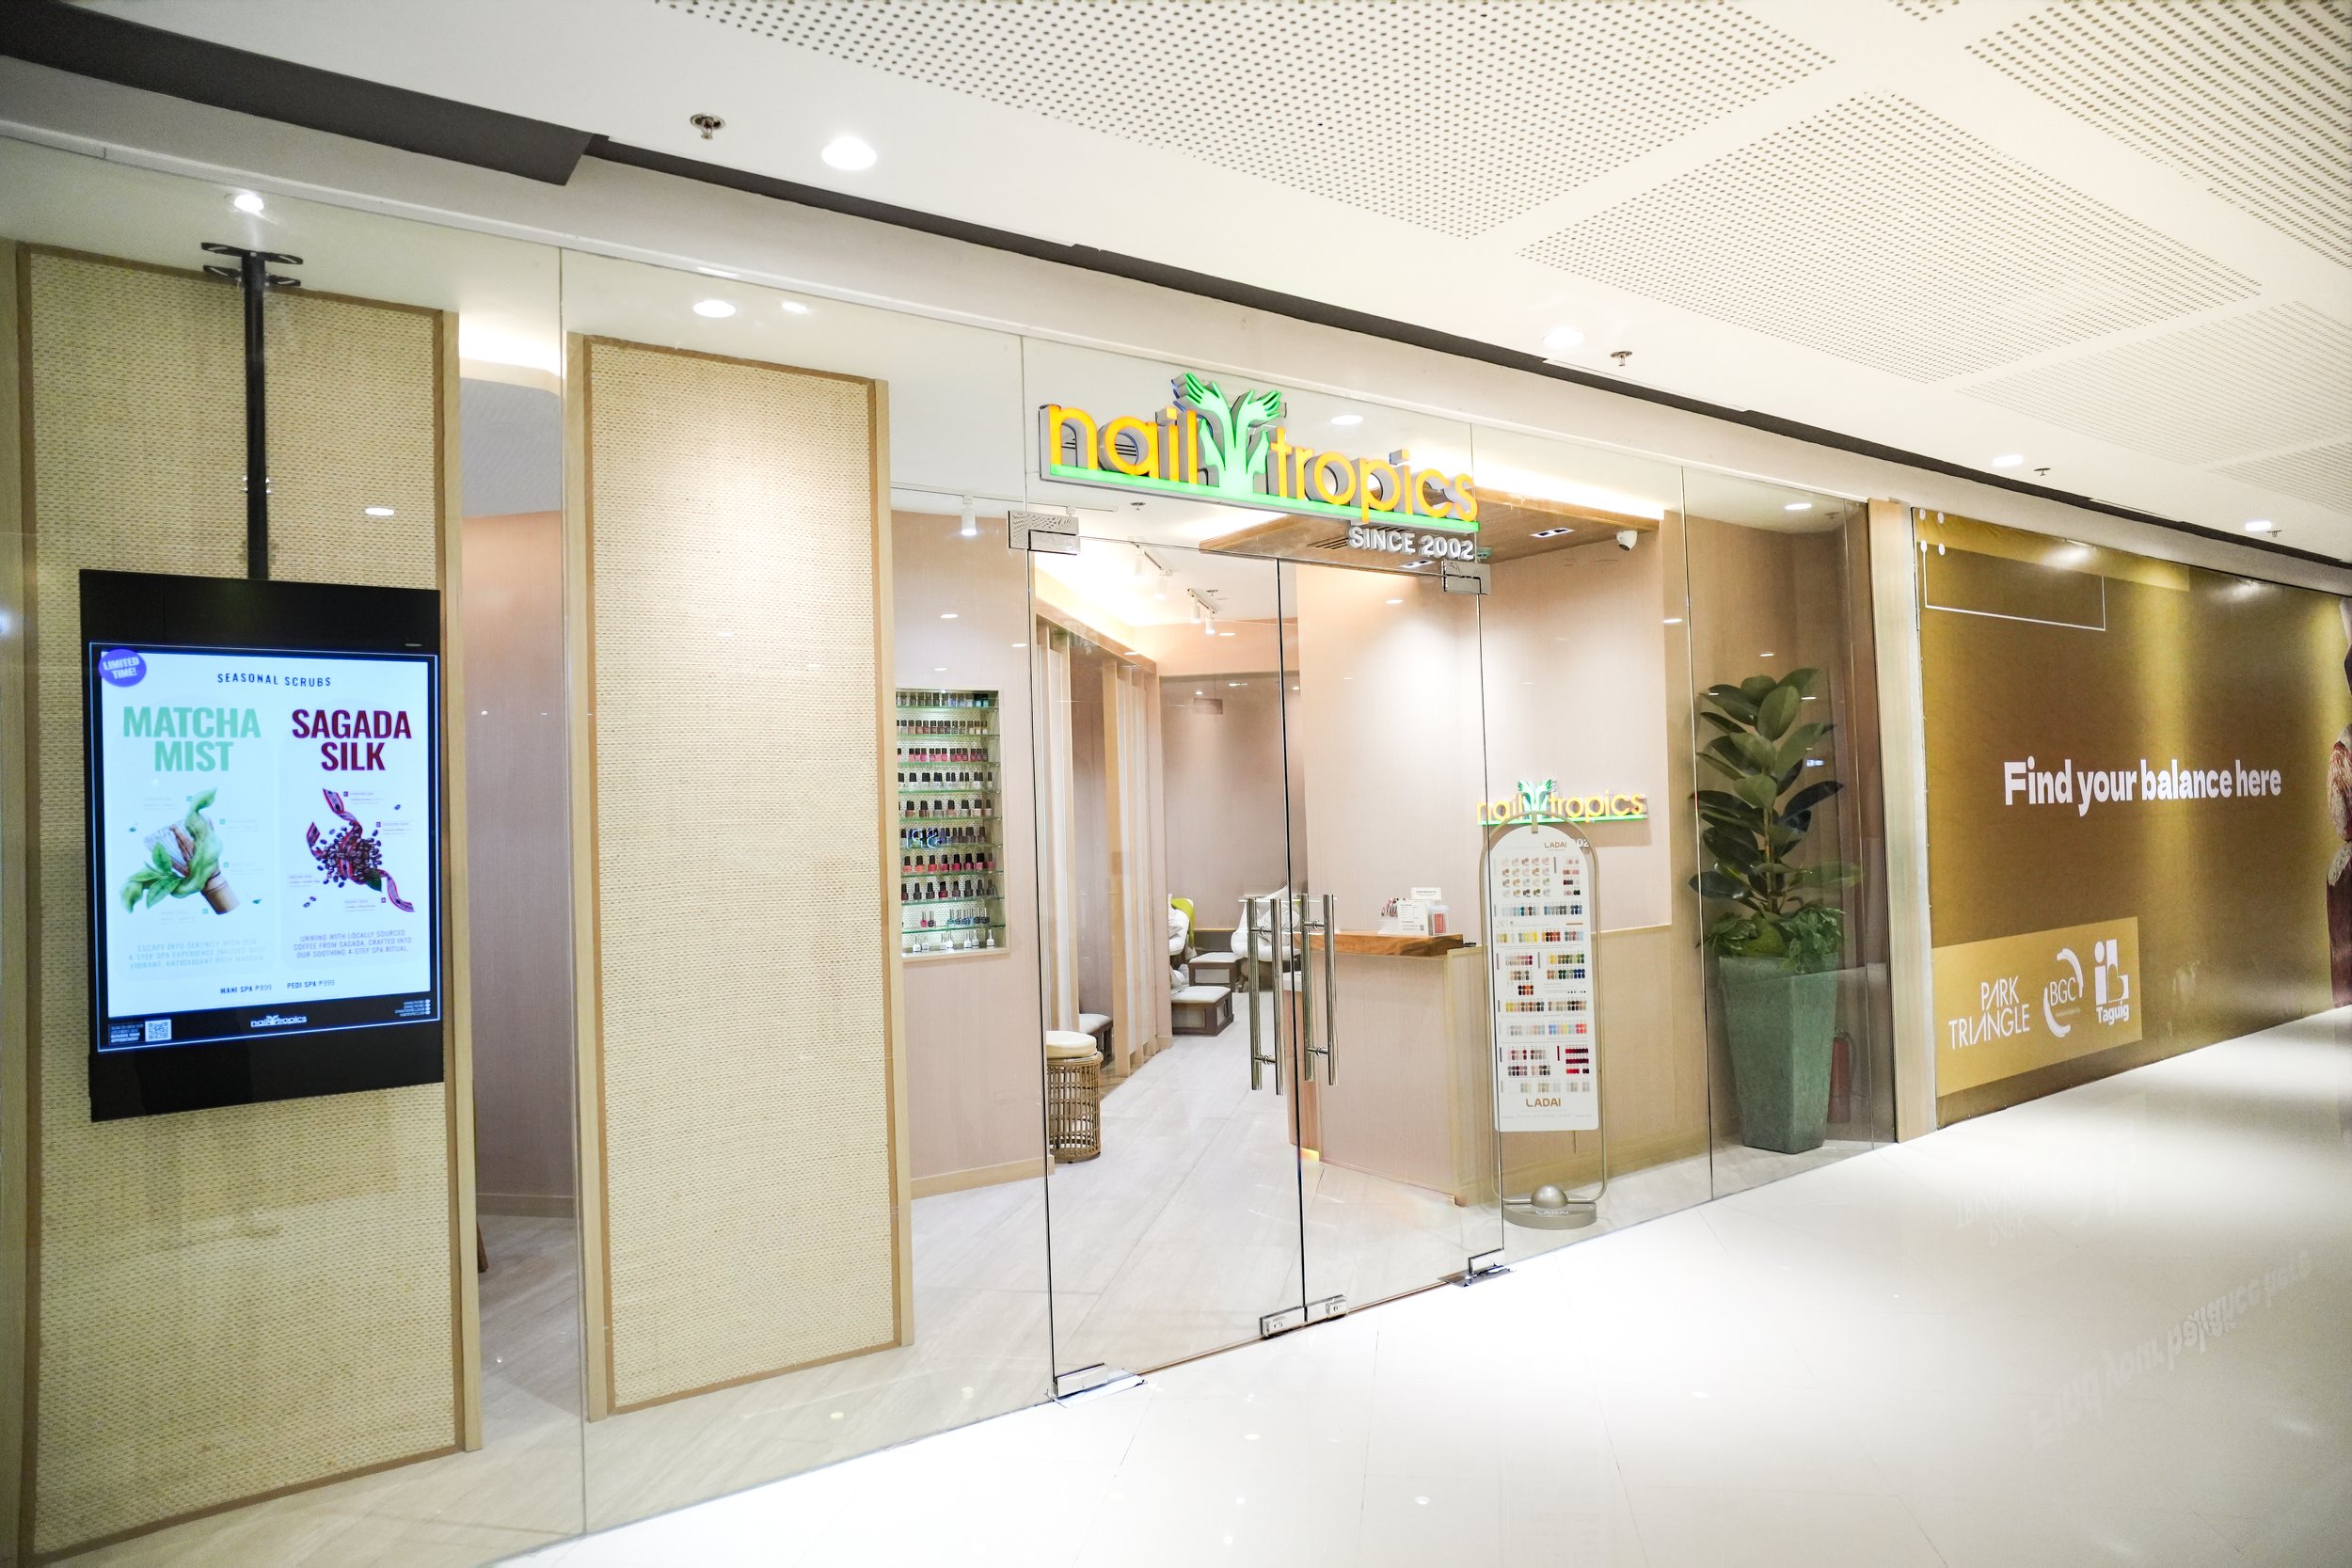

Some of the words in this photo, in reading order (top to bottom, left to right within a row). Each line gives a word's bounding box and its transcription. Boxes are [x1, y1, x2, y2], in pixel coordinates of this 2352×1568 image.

[1042, 404, 1198, 485] nail
[1268, 427, 1479, 524] tropics
[1347, 526, 1416, 554] SINCE
[1419, 534, 1475, 562] 2002
[103, 657, 140, 671] LIMITED
[111, 667, 138, 680] TIME!
[217, 673, 278, 685] SEASONAL
[284, 676, 331, 688] SCRUBS
[123, 705, 262, 738] MATCHA
[292, 708, 412, 739] SAGADA
[154, 740, 234, 772] MIST
[321, 741, 386, 772] SILK
[2004, 755, 2073, 806] Find
[2076, 769, 2137, 817] your
[2140, 758, 2233, 800] balance
[2235, 759, 2281, 797] here
[1476, 792, 1523, 822] nail
[1548, 789, 1645, 823] tropics
[294, 942, 317, 951] COFFEE
[1980, 974, 2020, 1011] PARK
[2050, 976, 2077, 1006] BGC
[1948, 1004, 2030, 1050] TRIANGLE
[2095, 1001, 2130, 1025] Taguig
[1526, 1098, 1562, 1108] LADAI
